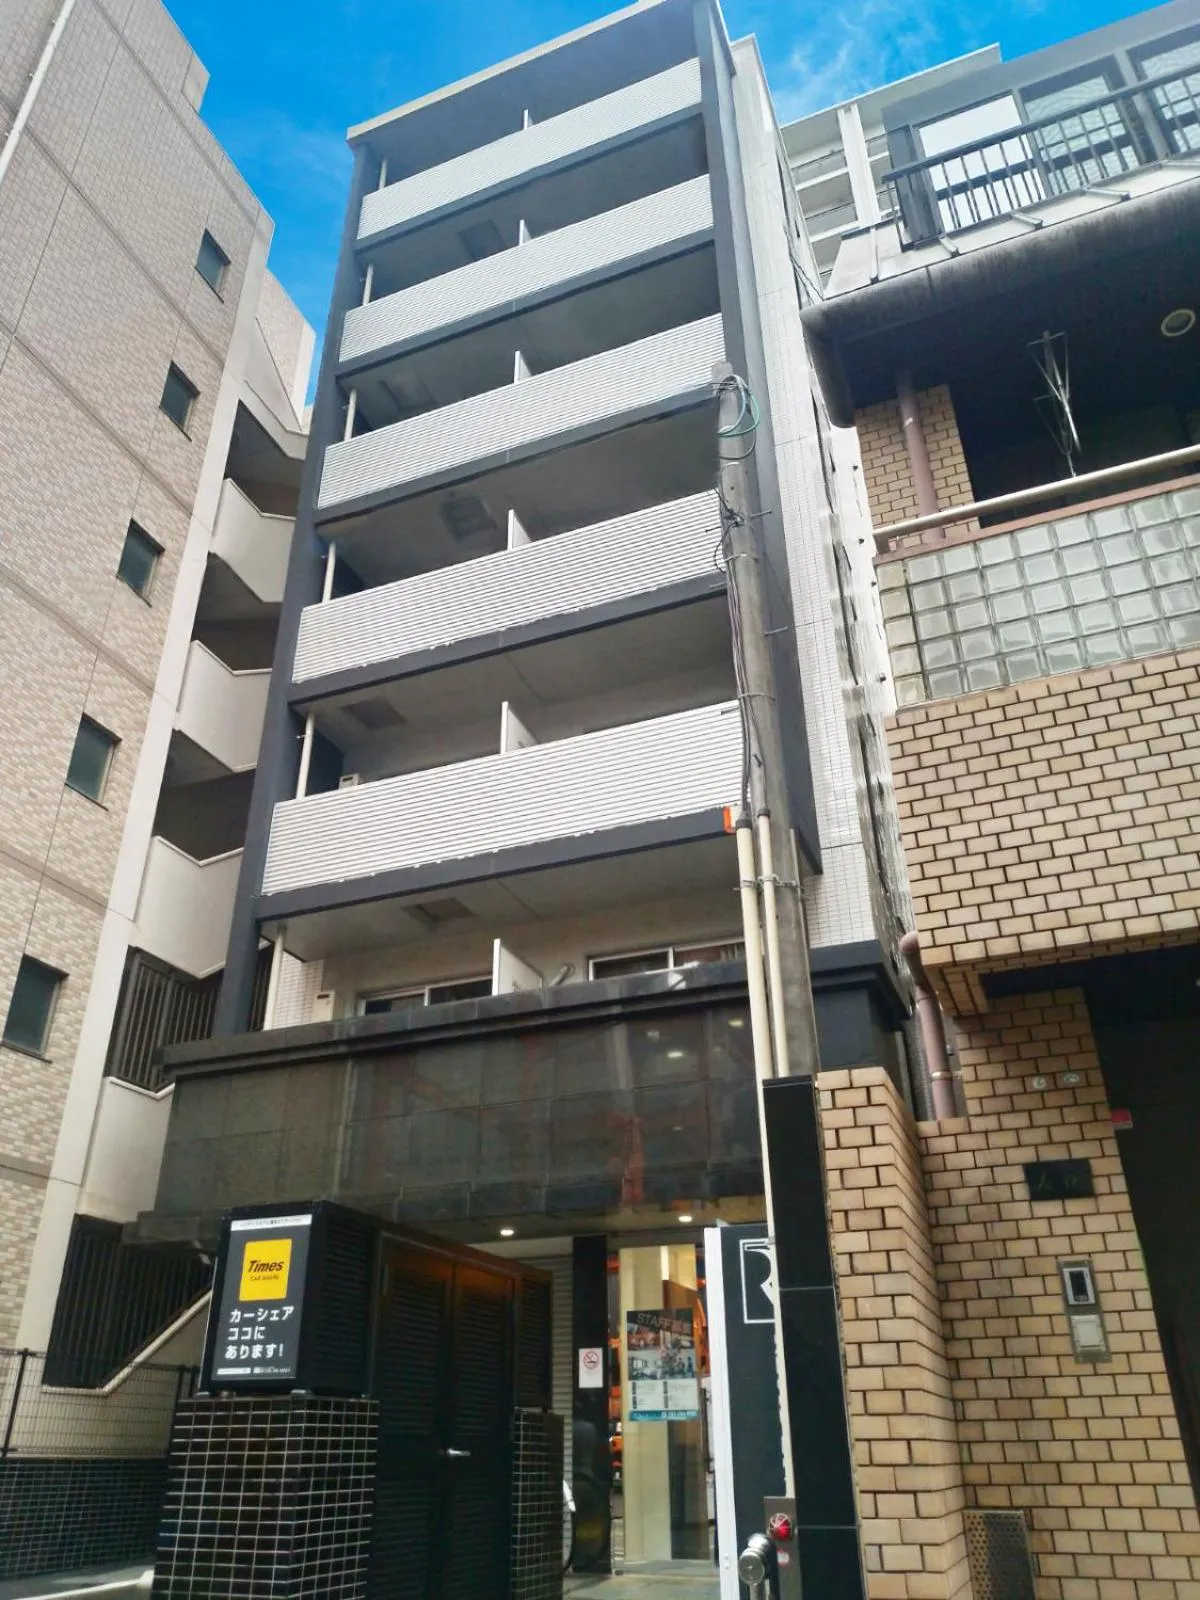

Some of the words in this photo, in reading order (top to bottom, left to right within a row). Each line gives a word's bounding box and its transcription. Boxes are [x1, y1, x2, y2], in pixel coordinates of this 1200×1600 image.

[248, 1260, 284, 1273] Times
[230, 1306, 294, 1323] カーシェア
[228, 1326, 266, 1341] ココに
